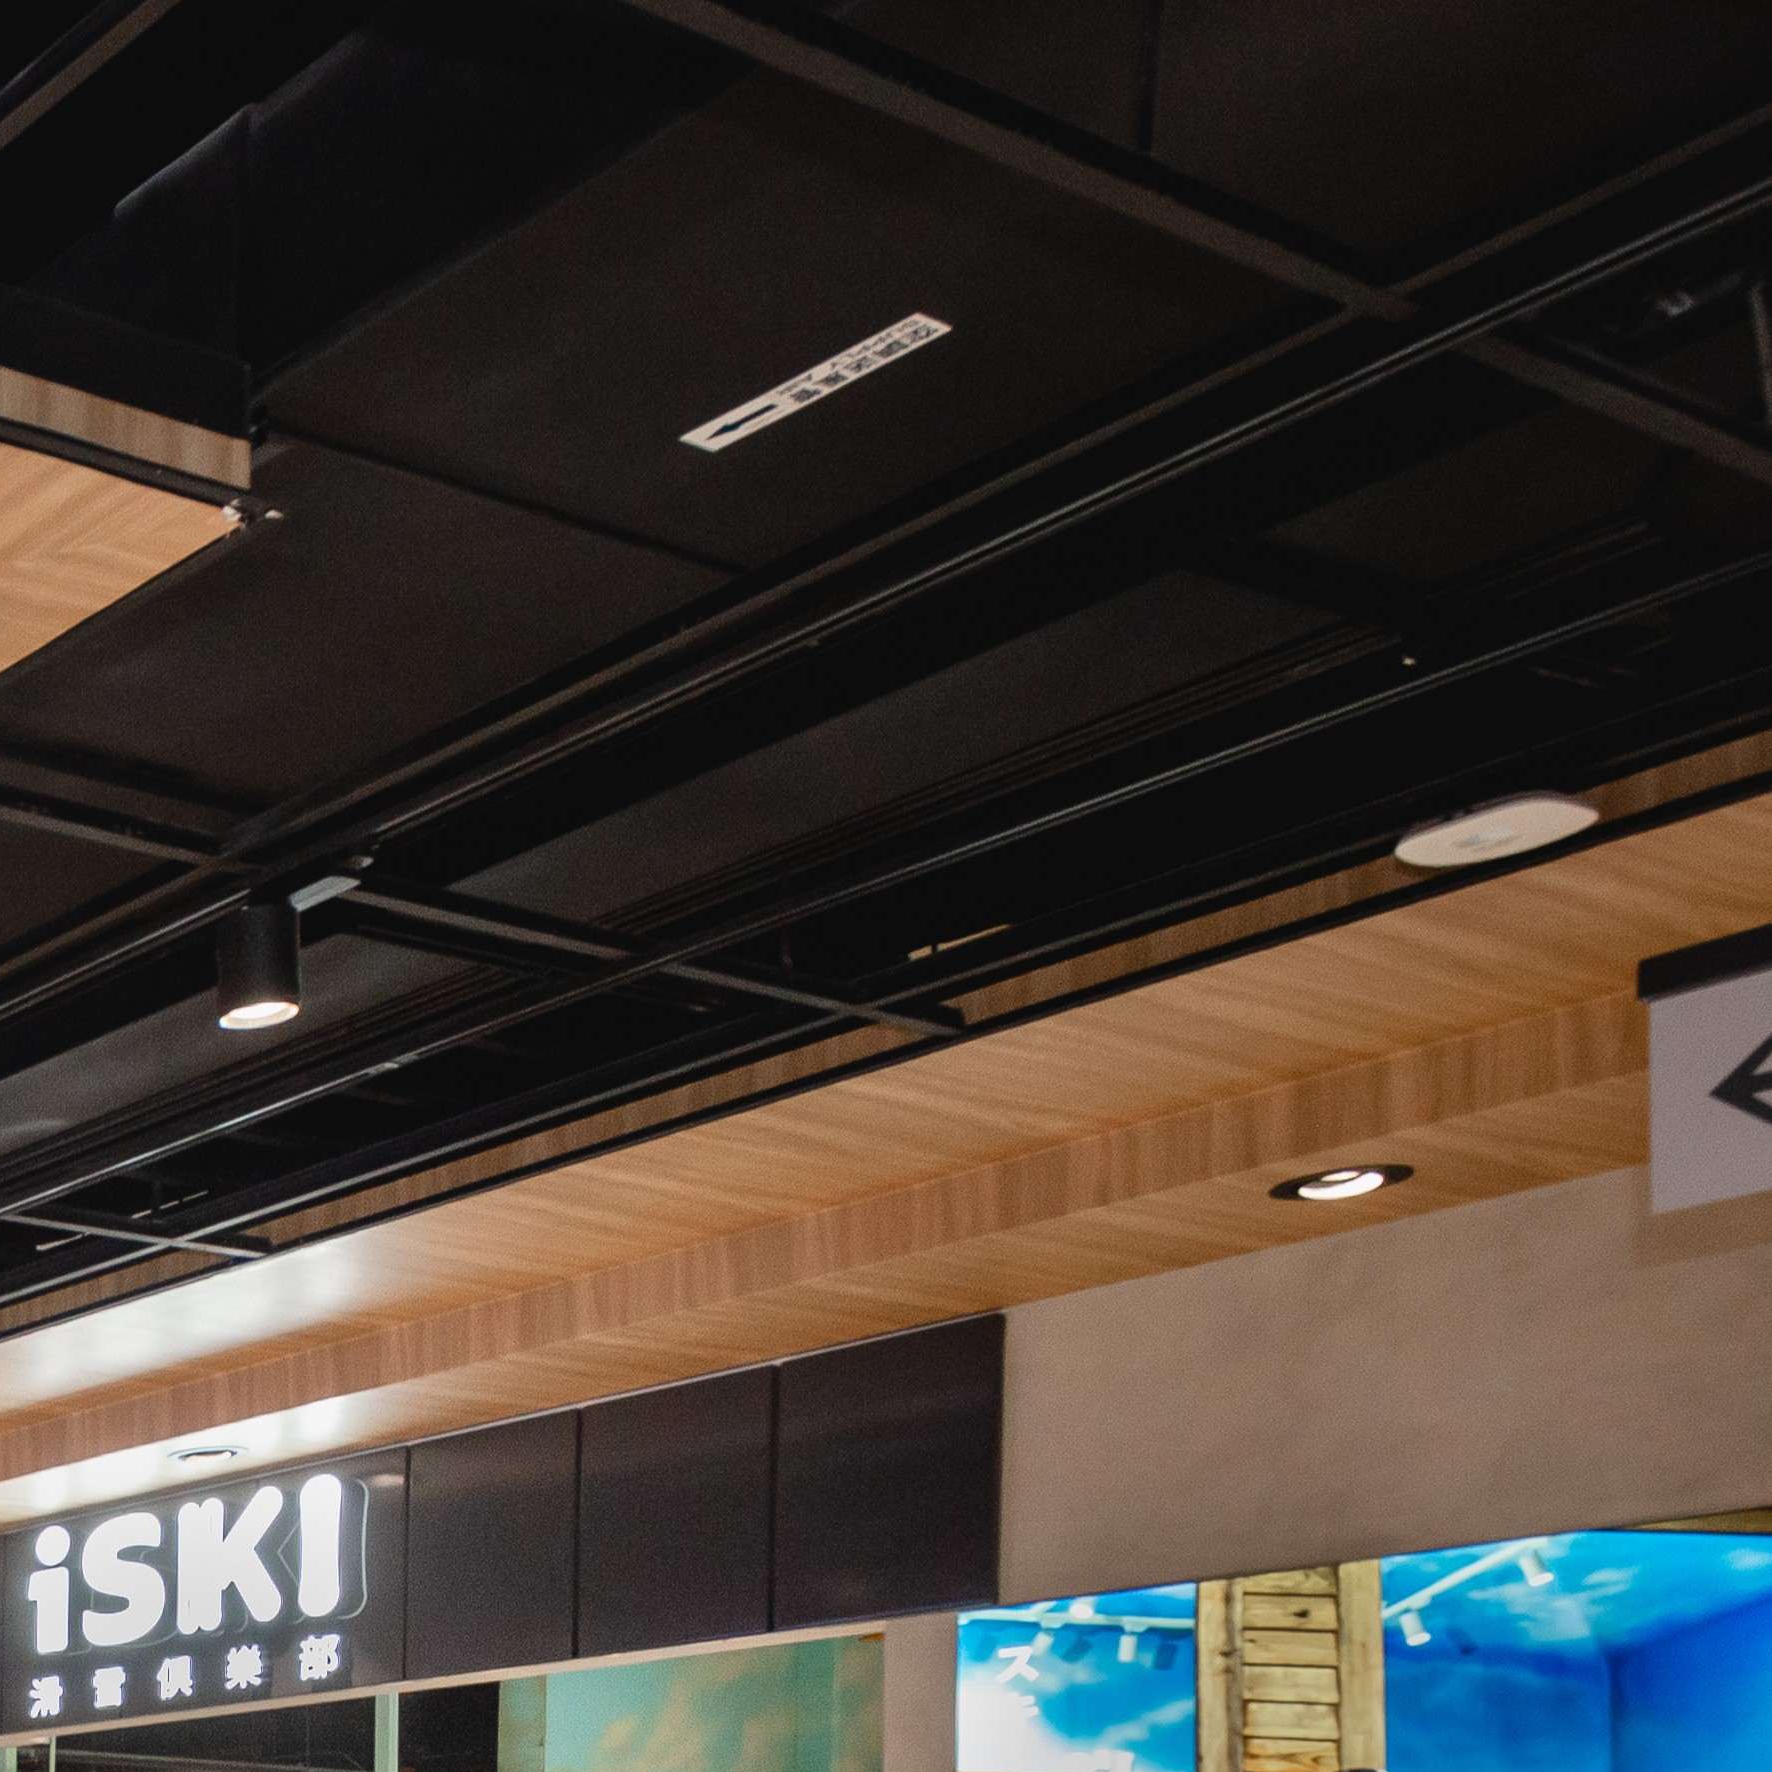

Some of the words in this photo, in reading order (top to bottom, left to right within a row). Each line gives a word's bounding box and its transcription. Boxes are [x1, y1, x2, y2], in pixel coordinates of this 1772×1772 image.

[28, 1473, 343, 1656] iSKI
[29, 1633, 342, 1719] 滑雪俱樂部
